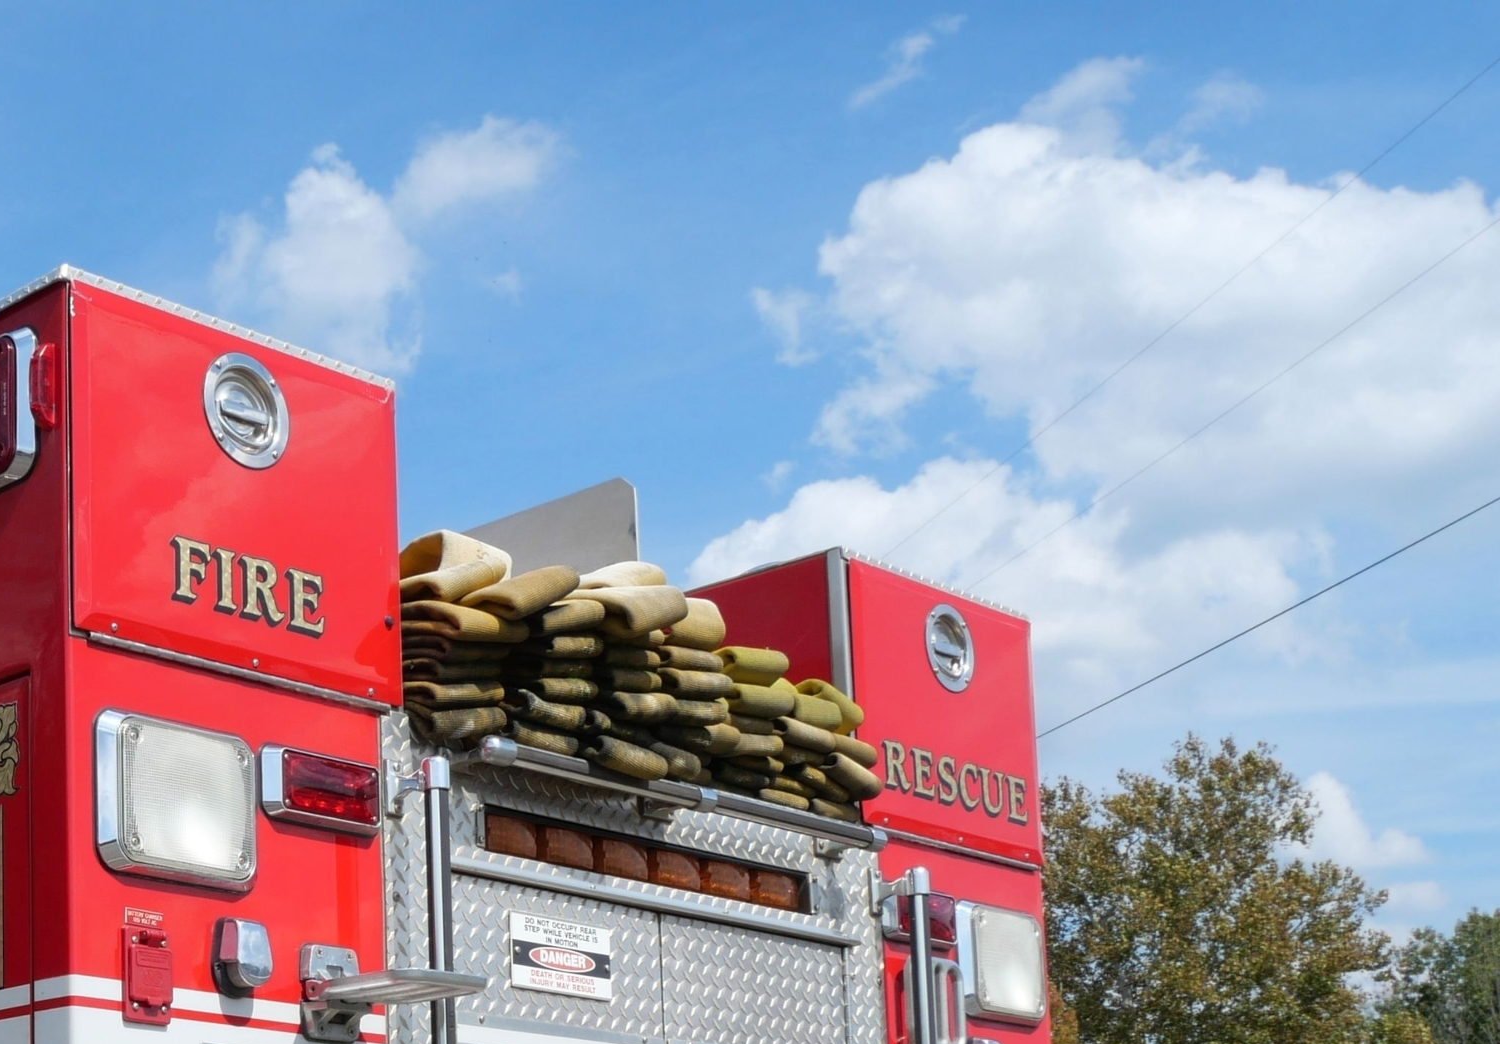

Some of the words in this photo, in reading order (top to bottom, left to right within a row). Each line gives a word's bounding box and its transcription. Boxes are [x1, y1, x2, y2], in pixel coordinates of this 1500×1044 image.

[170, 534, 325, 638] FIRE
[882, 739, 1029, 824] RESCUE
[524, 925, 540, 933] STEP
[543, 928, 562, 937] WHILE
[565, 932, 590, 942] VEHICLE
[537, 919, 549, 927] NOT
[552, 922, 577, 931] OCCUPY
[580, 927, 596, 935] REAR
[555, 938, 578, 948] MOTION
[540, 950, 586, 968] DANGER
[530, 978, 553, 987] INJURY
[557, 982, 570, 990] MAY
[573, 984, 596, 993] RESULT
[531, 970, 552, 979] DEATH
[567, 975, 595, 985] SERIOUS
